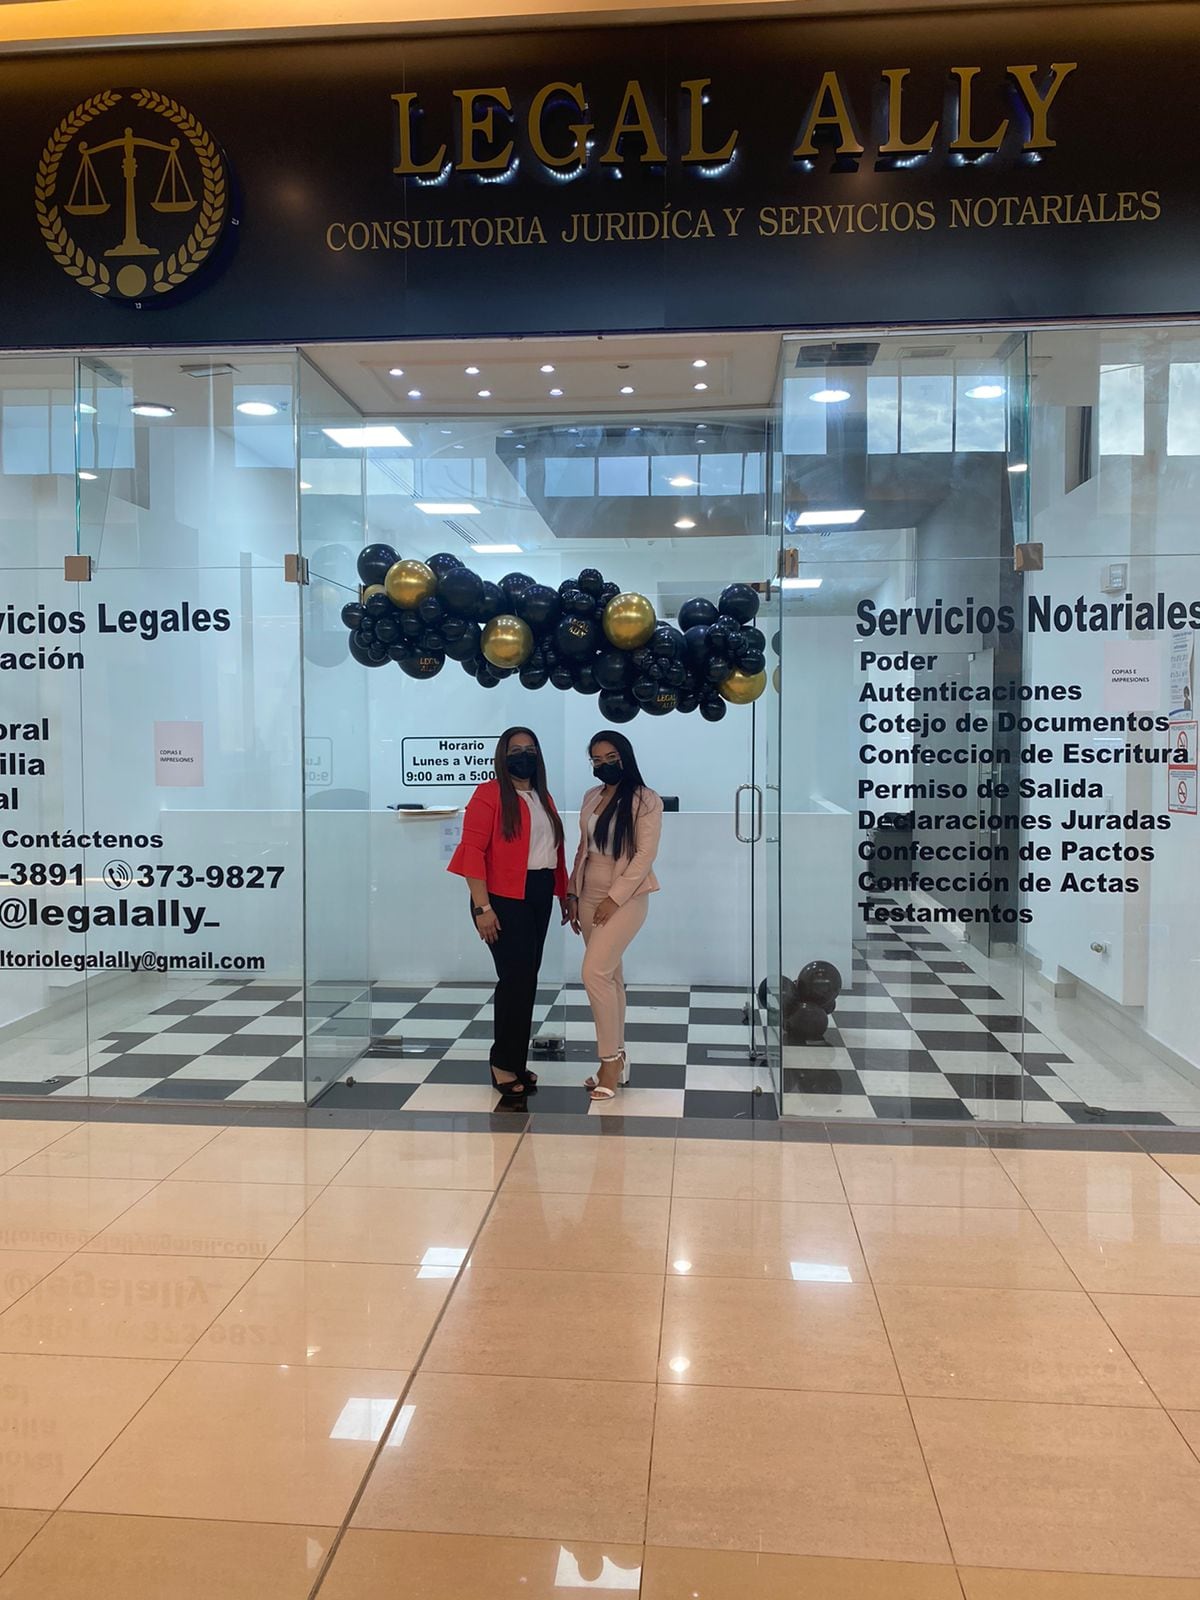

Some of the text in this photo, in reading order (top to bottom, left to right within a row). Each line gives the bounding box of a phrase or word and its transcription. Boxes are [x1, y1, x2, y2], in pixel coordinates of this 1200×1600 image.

[391, 62, 1078, 174] LEGAL ALLY
[326, 190, 1162, 252] CONSULTORIA JURIDÍCA Y SERVICIOS NOTARIALES
[0, 602, 231, 641] icios Legales
[856, 597, 1016, 636] Servicios
[860, 651, 938, 671] Poder
[859, 681, 1082, 703] Autenticaciones
[859, 712, 1170, 737] Cotejo de Documentos
[439, 740, 485, 750] Horario
[859, 743, 1189, 764] Confeccion de Escritura
[413, 757, 449, 766] Lunes
[406, 771, 495, 781] 9:00 am a 5:00
[858, 778, 1103, 799] Permiso de Salida
[858, 809, 1171, 830] Declaraciones Juradas
[2, 830, 164, 848] Contáctenos
[858, 841, 1155, 862] Confeccion de Pactos
[0, 863, 285, 889] -3891 373-9827
[858, 872, 1139, 893] Confección de Actas
[0, 898, 220, 934] @legalally_
[858, 902, 1033, 923] Testamentos
